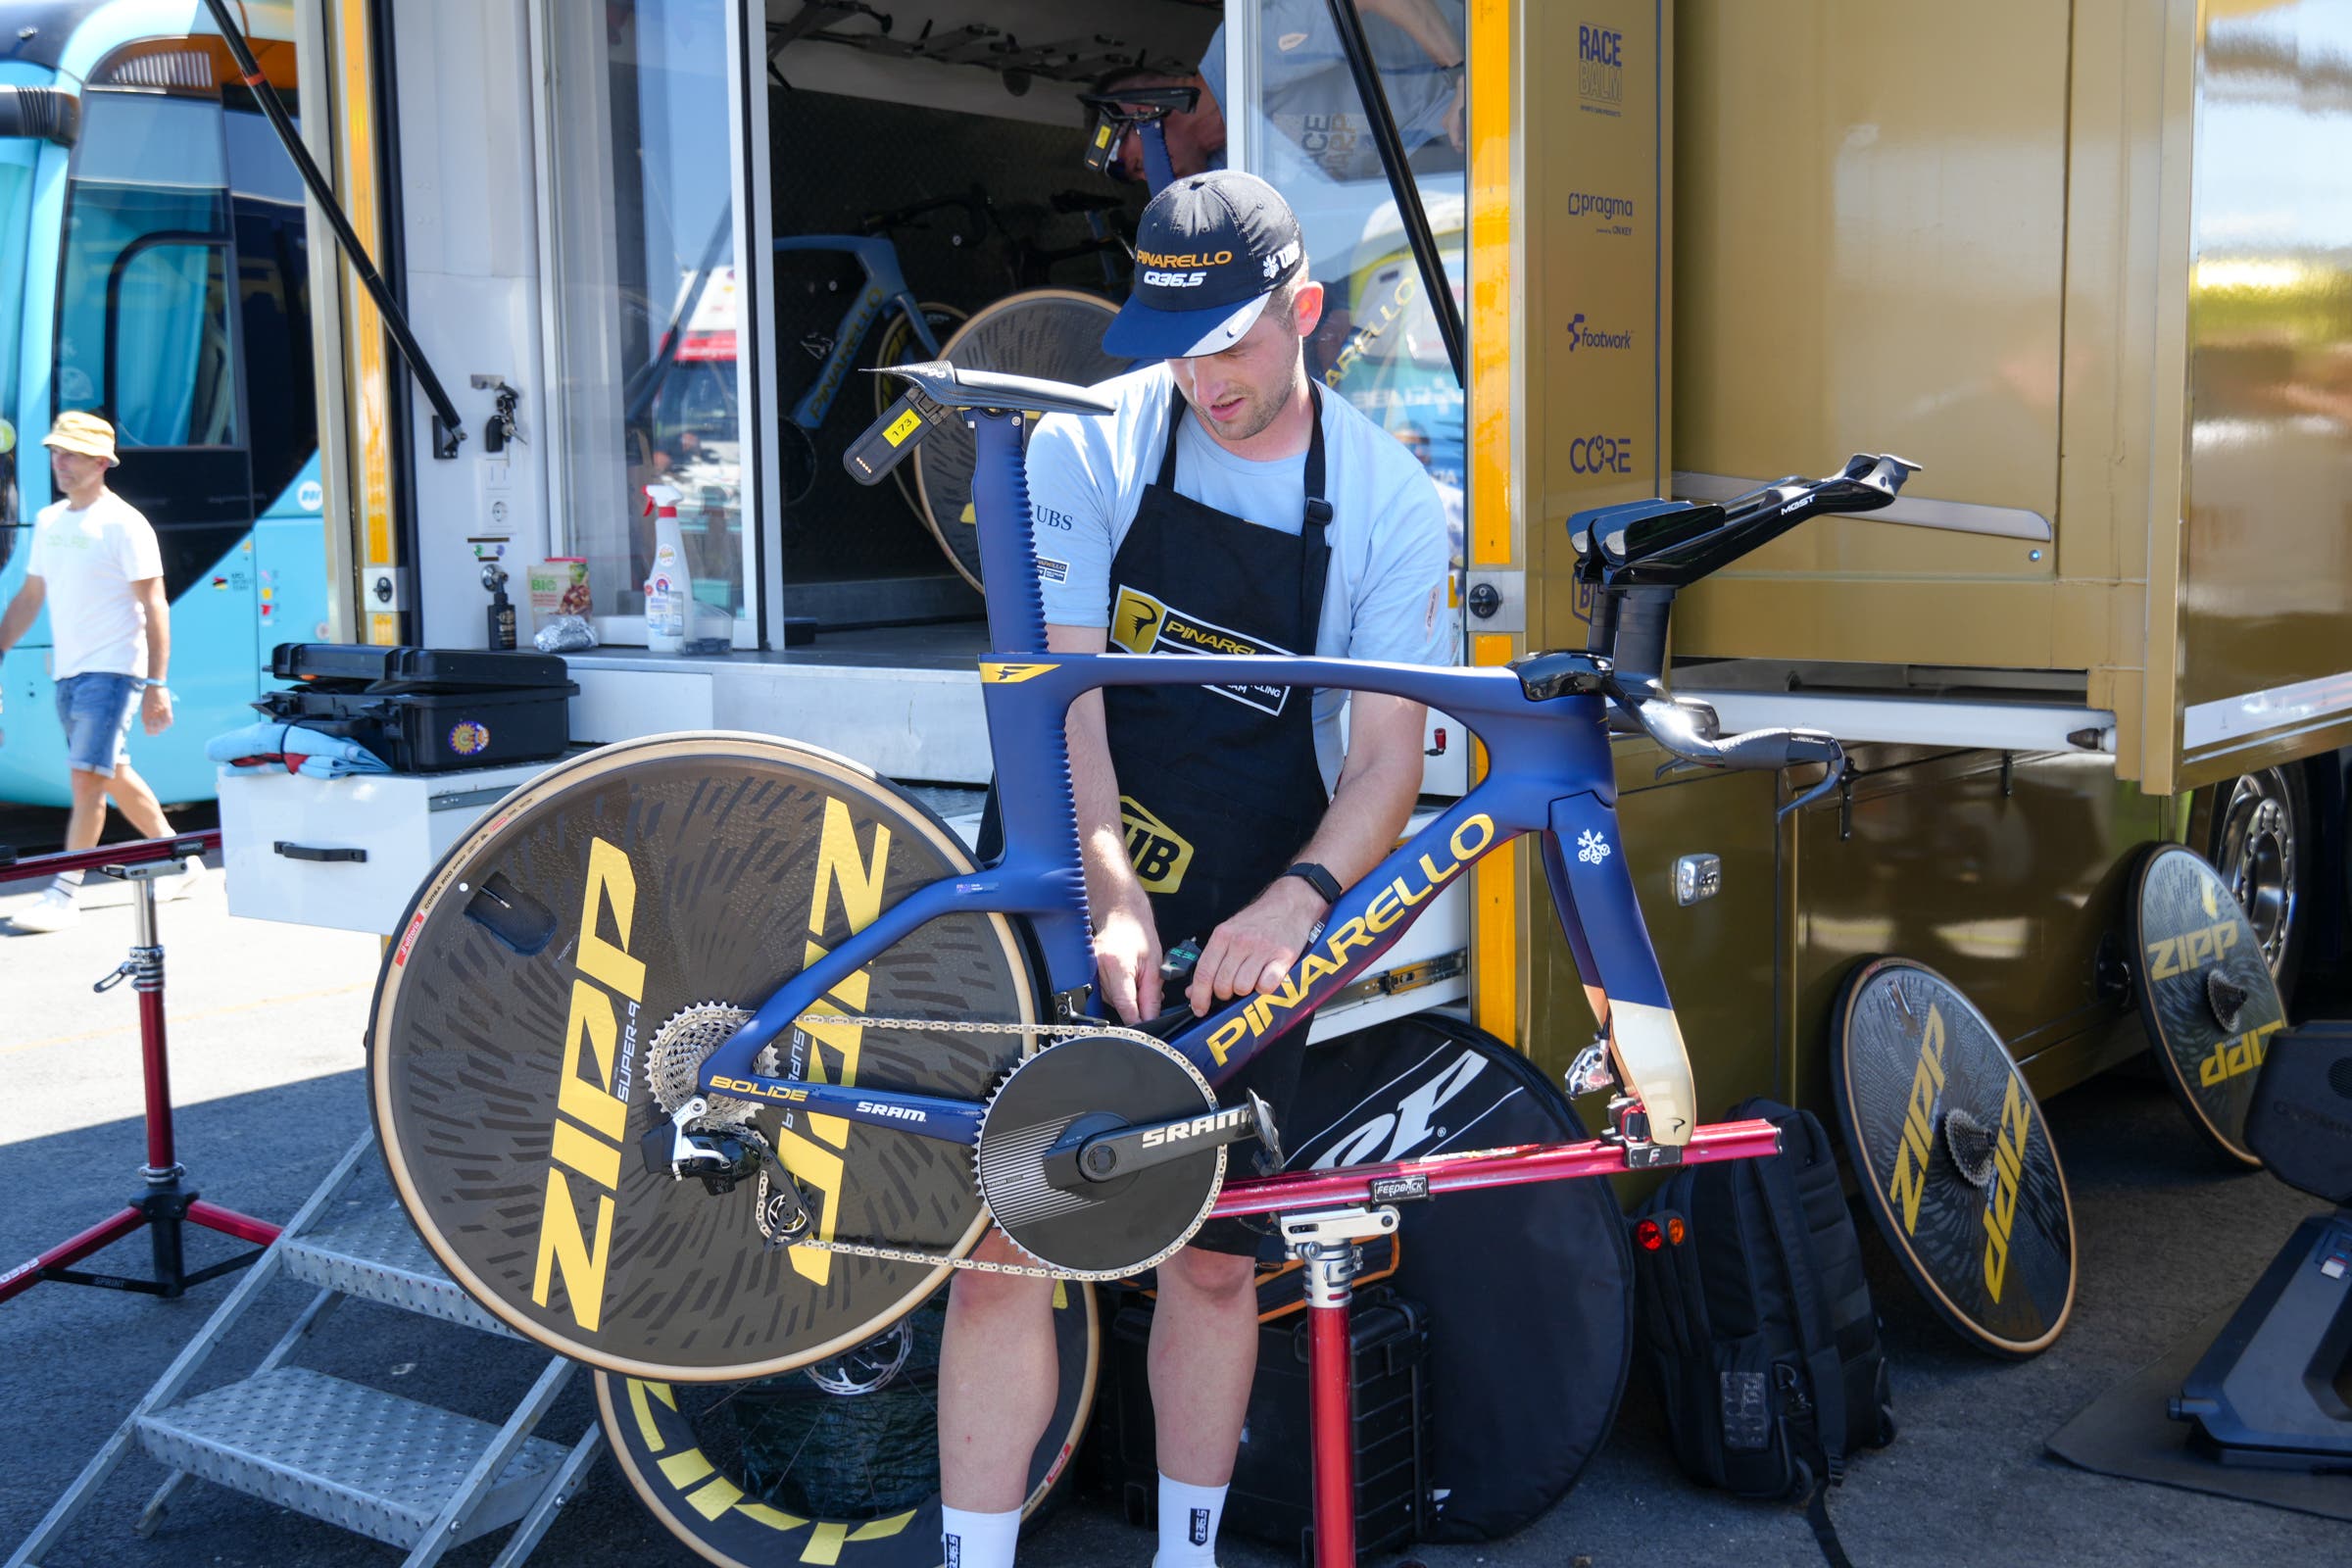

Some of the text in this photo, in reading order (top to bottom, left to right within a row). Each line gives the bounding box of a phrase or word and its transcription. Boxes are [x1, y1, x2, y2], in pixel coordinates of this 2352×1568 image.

[1579, 25, 1623, 68] RACE
[1579, 60, 1623, 103] BALM
[1582, 194, 1633, 220] pragma
[1136, 250, 1233, 269] PINARELLO
[1144, 271, 1207, 287] Q36.5
[1582, 326, 1632, 350] footwork
[892, 417, 912, 437] 173
[1036, 505, 1073, 531] UBS
[1205, 813, 1495, 1067] PINARELLO
[2148, 919, 2239, 982] ZIPP
[618, 1001, 641, 1103] SUPER-9
[531, 836, 647, 1333] ZIPP
[710, 1075, 808, 1102] BOLIDE
[856, 1102, 926, 1122] SRAM
[1889, 1003, 1944, 1238] ZIPP
[1376, 1179, 1424, 1196] FEEDBACK
[1982, 1070, 2031, 1304] ZIPP
